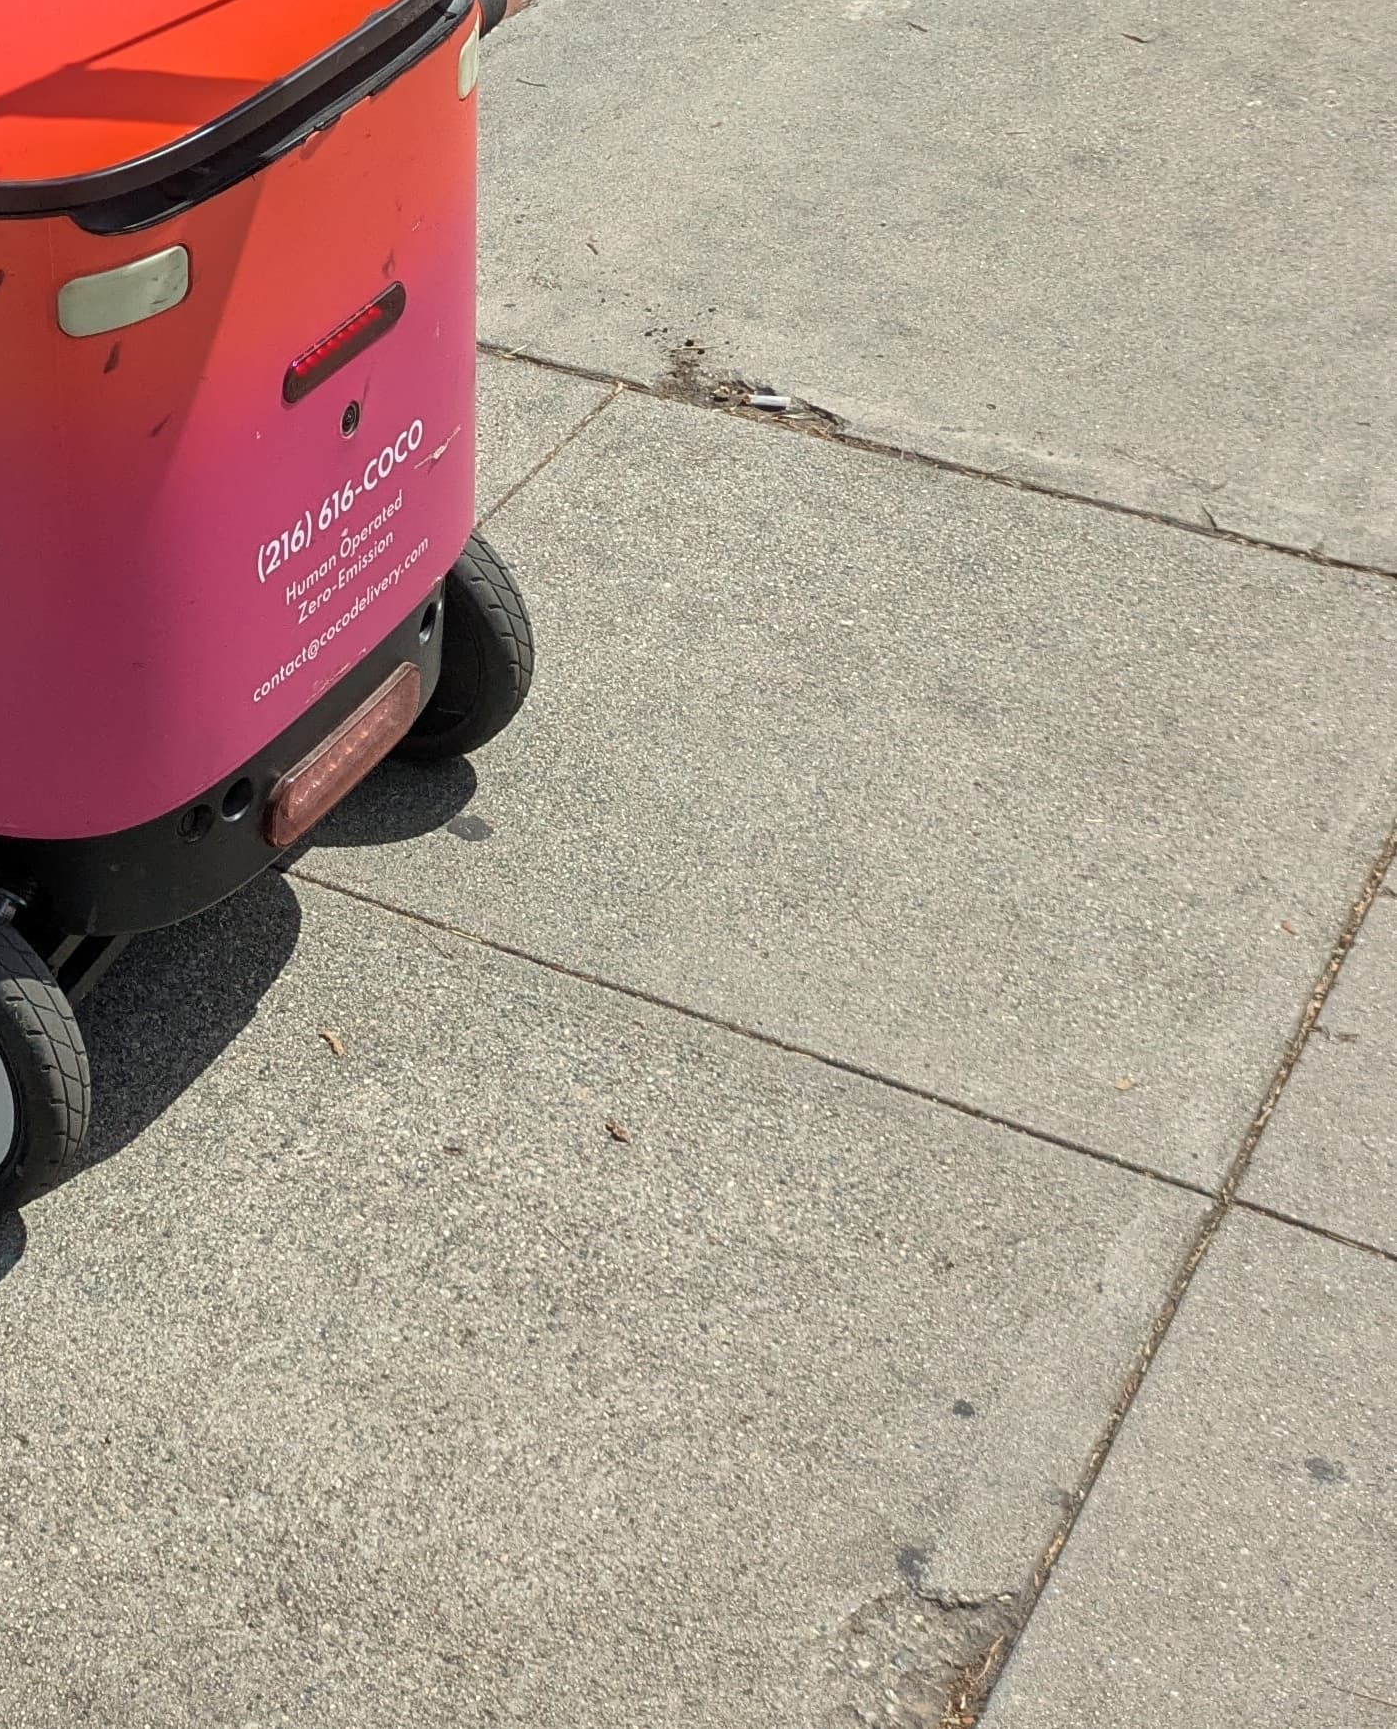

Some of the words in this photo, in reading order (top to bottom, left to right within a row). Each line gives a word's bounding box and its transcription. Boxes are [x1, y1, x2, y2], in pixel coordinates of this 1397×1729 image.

[257, 510, 312, 583] (216)
[318, 419, 423, 530] 616-COCO
[286, 554, 337, 605] Human
[340, 488, 403, 558] Operated
[253, 537, 429, 702] contact@cocodelivery.com
[298, 531, 394, 624] Zero-Emission
